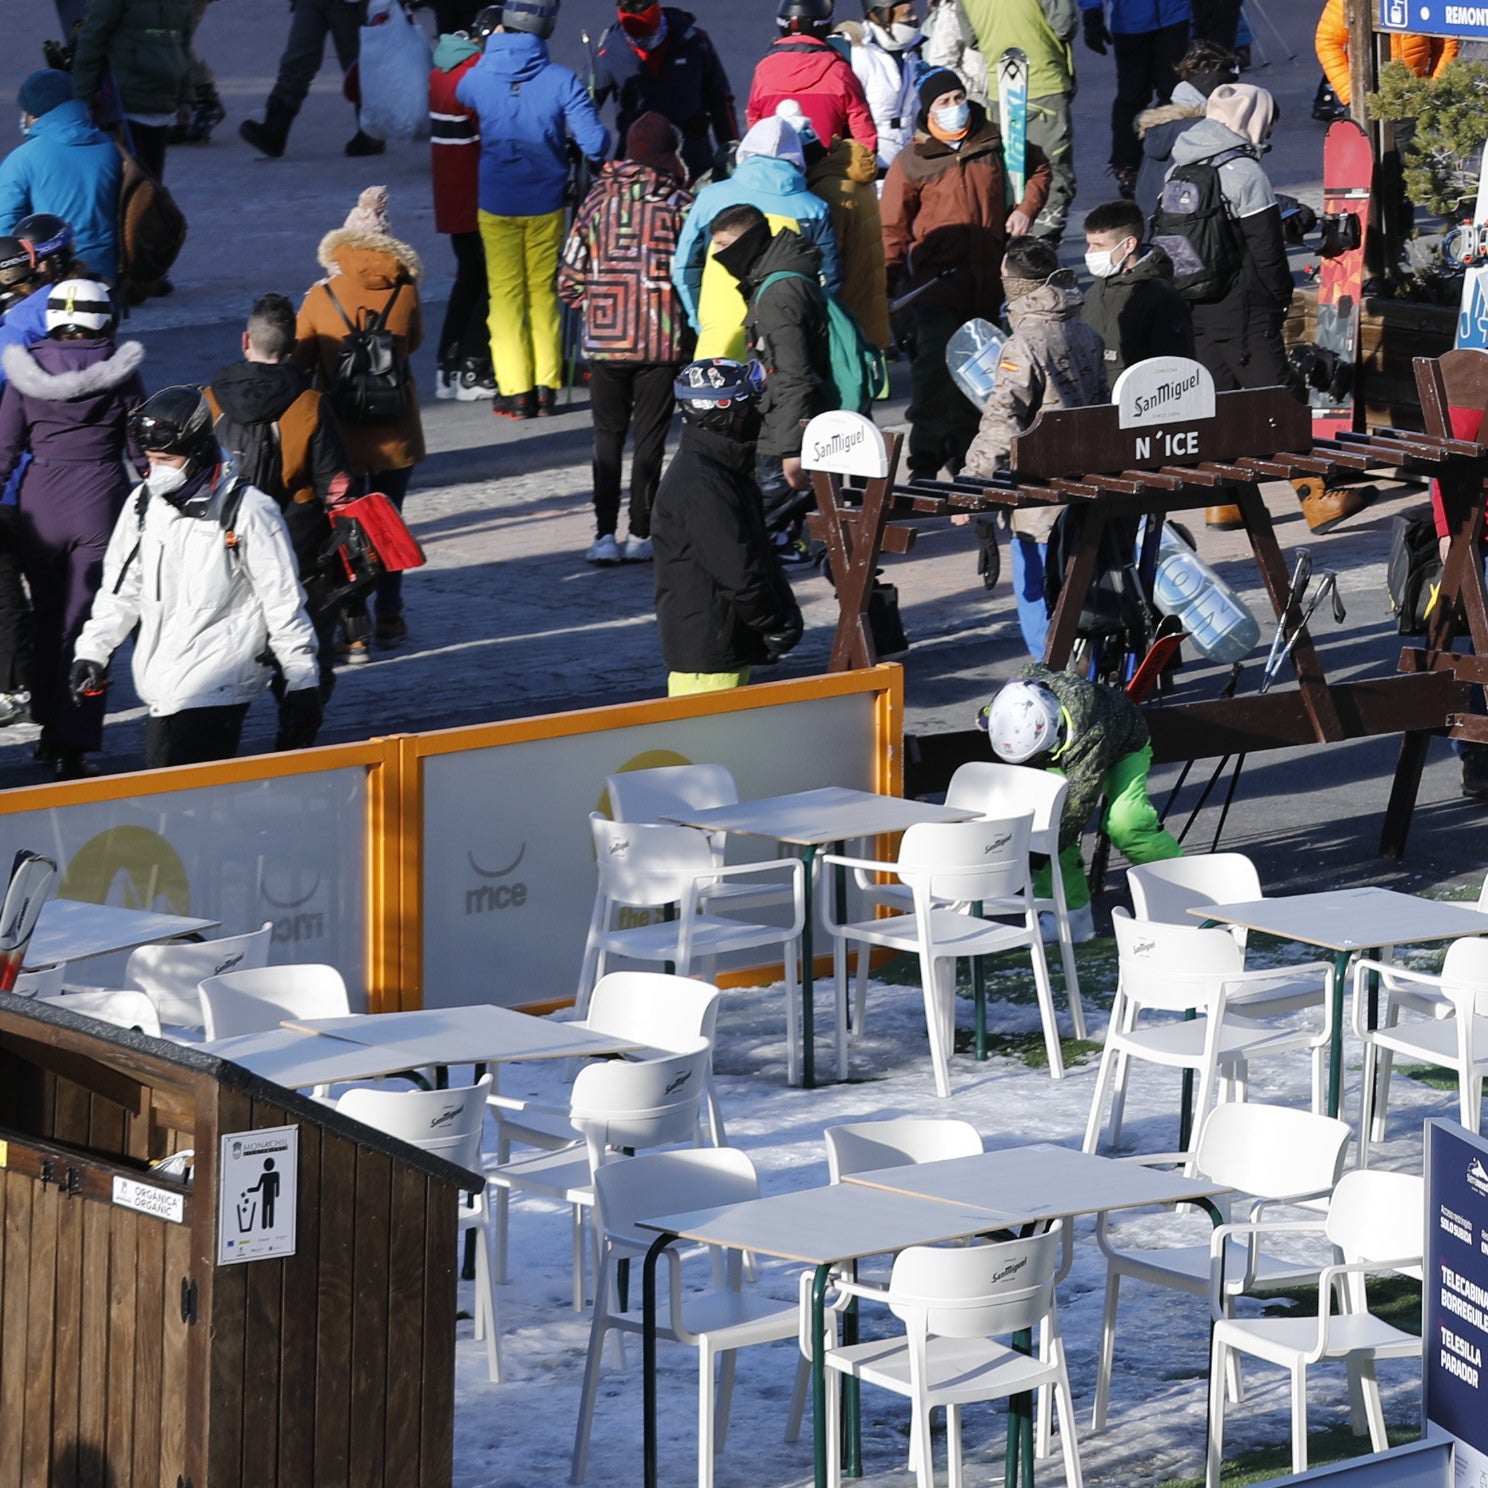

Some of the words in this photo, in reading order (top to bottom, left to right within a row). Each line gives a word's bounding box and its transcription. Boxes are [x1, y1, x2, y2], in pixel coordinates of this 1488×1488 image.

[1440, 1216, 1456, 1236] SOLO
[1441, 1325, 1482, 1368] TELESILLA
[1440, 1348, 1479, 1390] PARADOR
